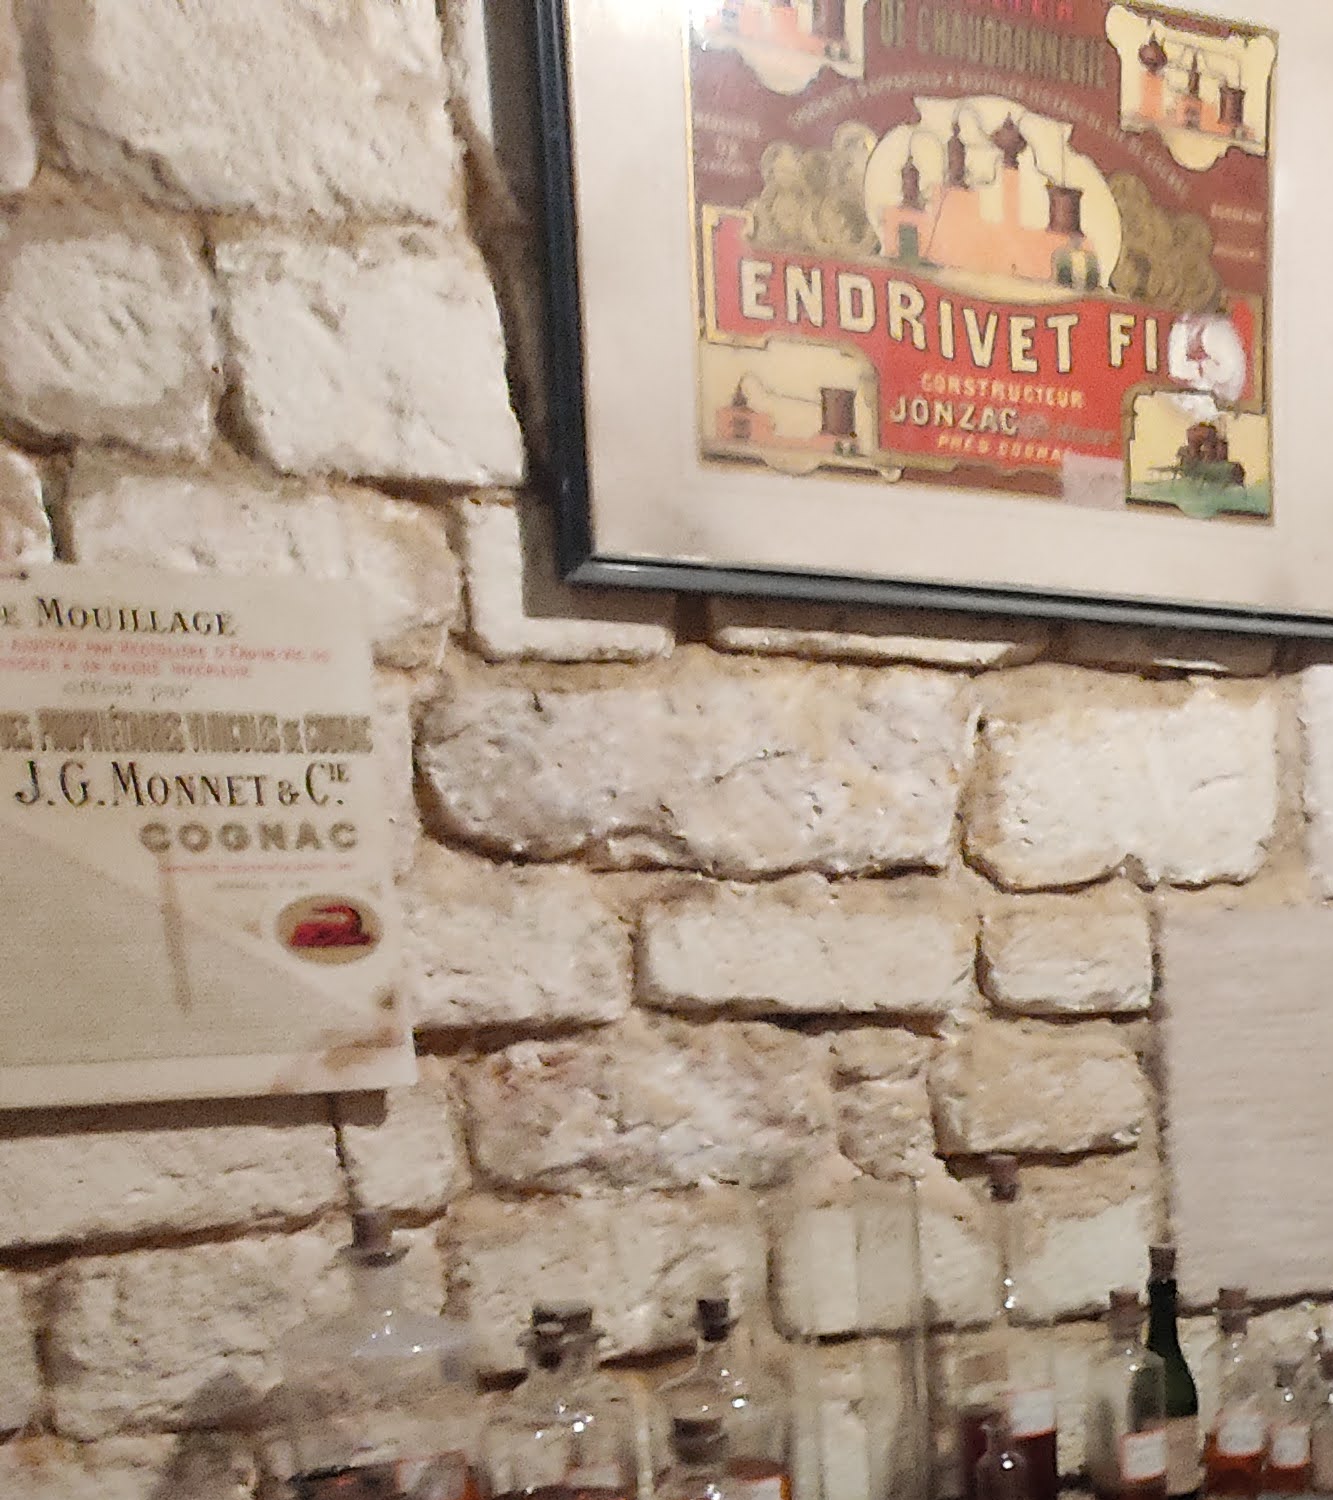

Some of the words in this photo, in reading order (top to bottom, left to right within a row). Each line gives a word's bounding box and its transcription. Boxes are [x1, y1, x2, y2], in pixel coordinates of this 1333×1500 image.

[740, 258, 1079, 374] ENDRIVET
[920, 372, 1086, 409] CONSTRUCTEUR
[889, 395, 1019, 436] JONZAC
[998, 441, 1063, 463] COGNA
[36, 595, 236, 636] MOUILLAGE
[139, 821, 358, 852] COGNAC
